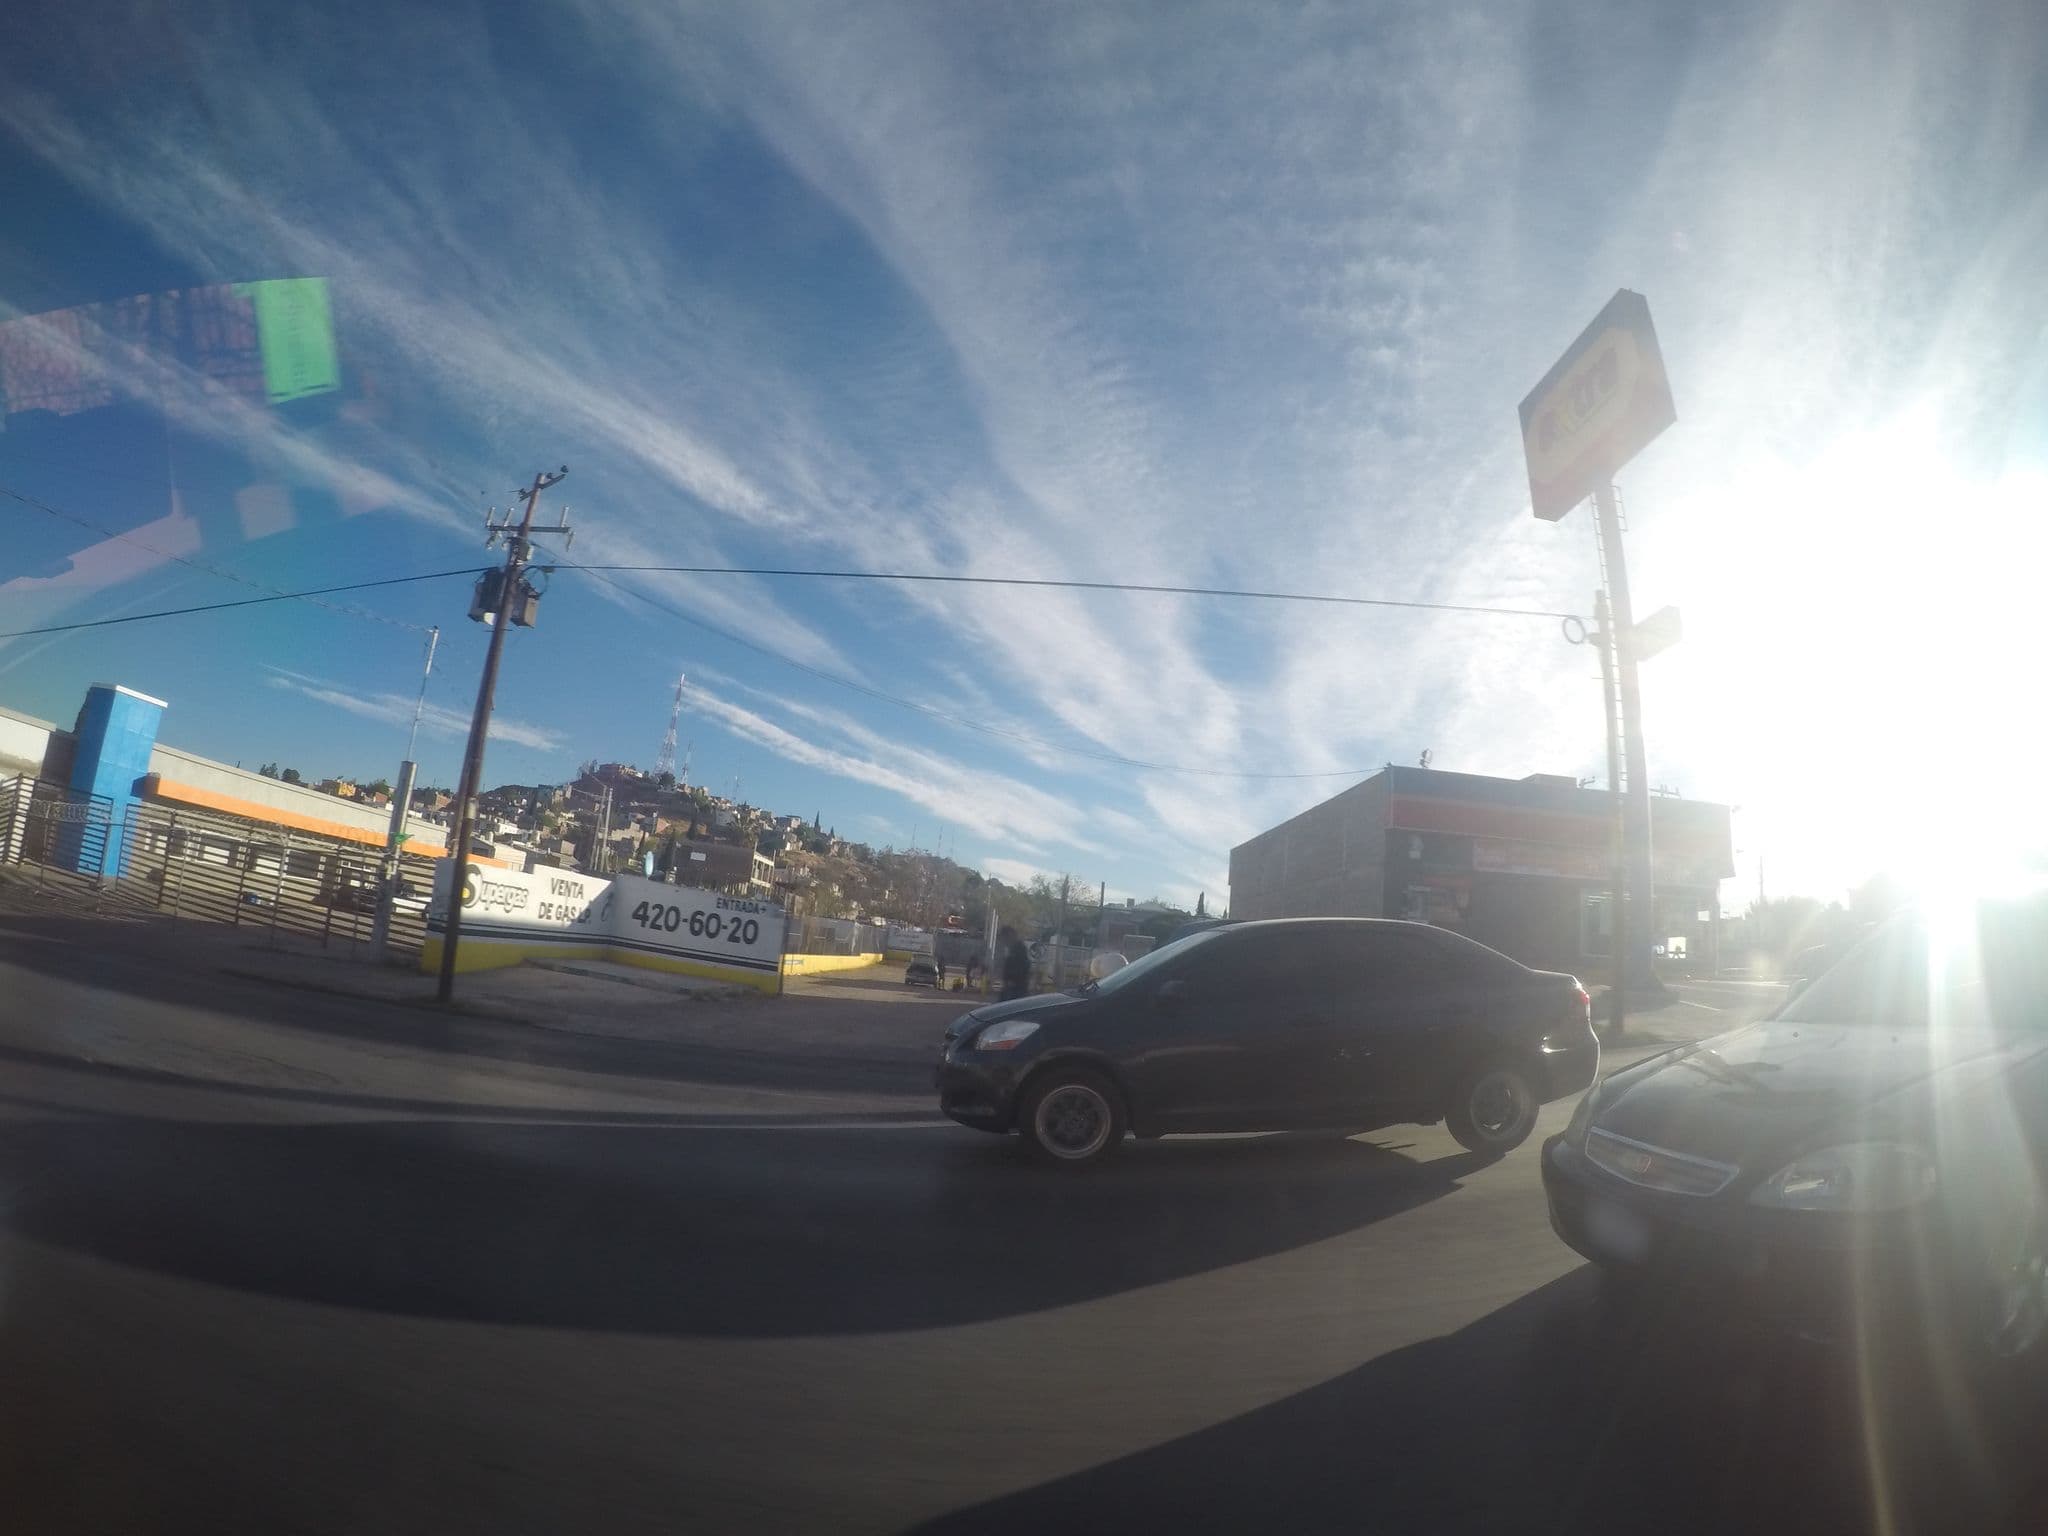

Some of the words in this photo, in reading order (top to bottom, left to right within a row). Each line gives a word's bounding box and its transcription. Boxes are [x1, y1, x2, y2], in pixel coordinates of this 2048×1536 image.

[460, 863, 530, 913] Supergas
[550, 877, 585, 900] VENTA
[538, 901, 553, 920] DE
[555, 904, 577, 922] GAS
[716, 897, 760, 915] ENTRADA
[631, 900, 759, 945] 420-60-20
